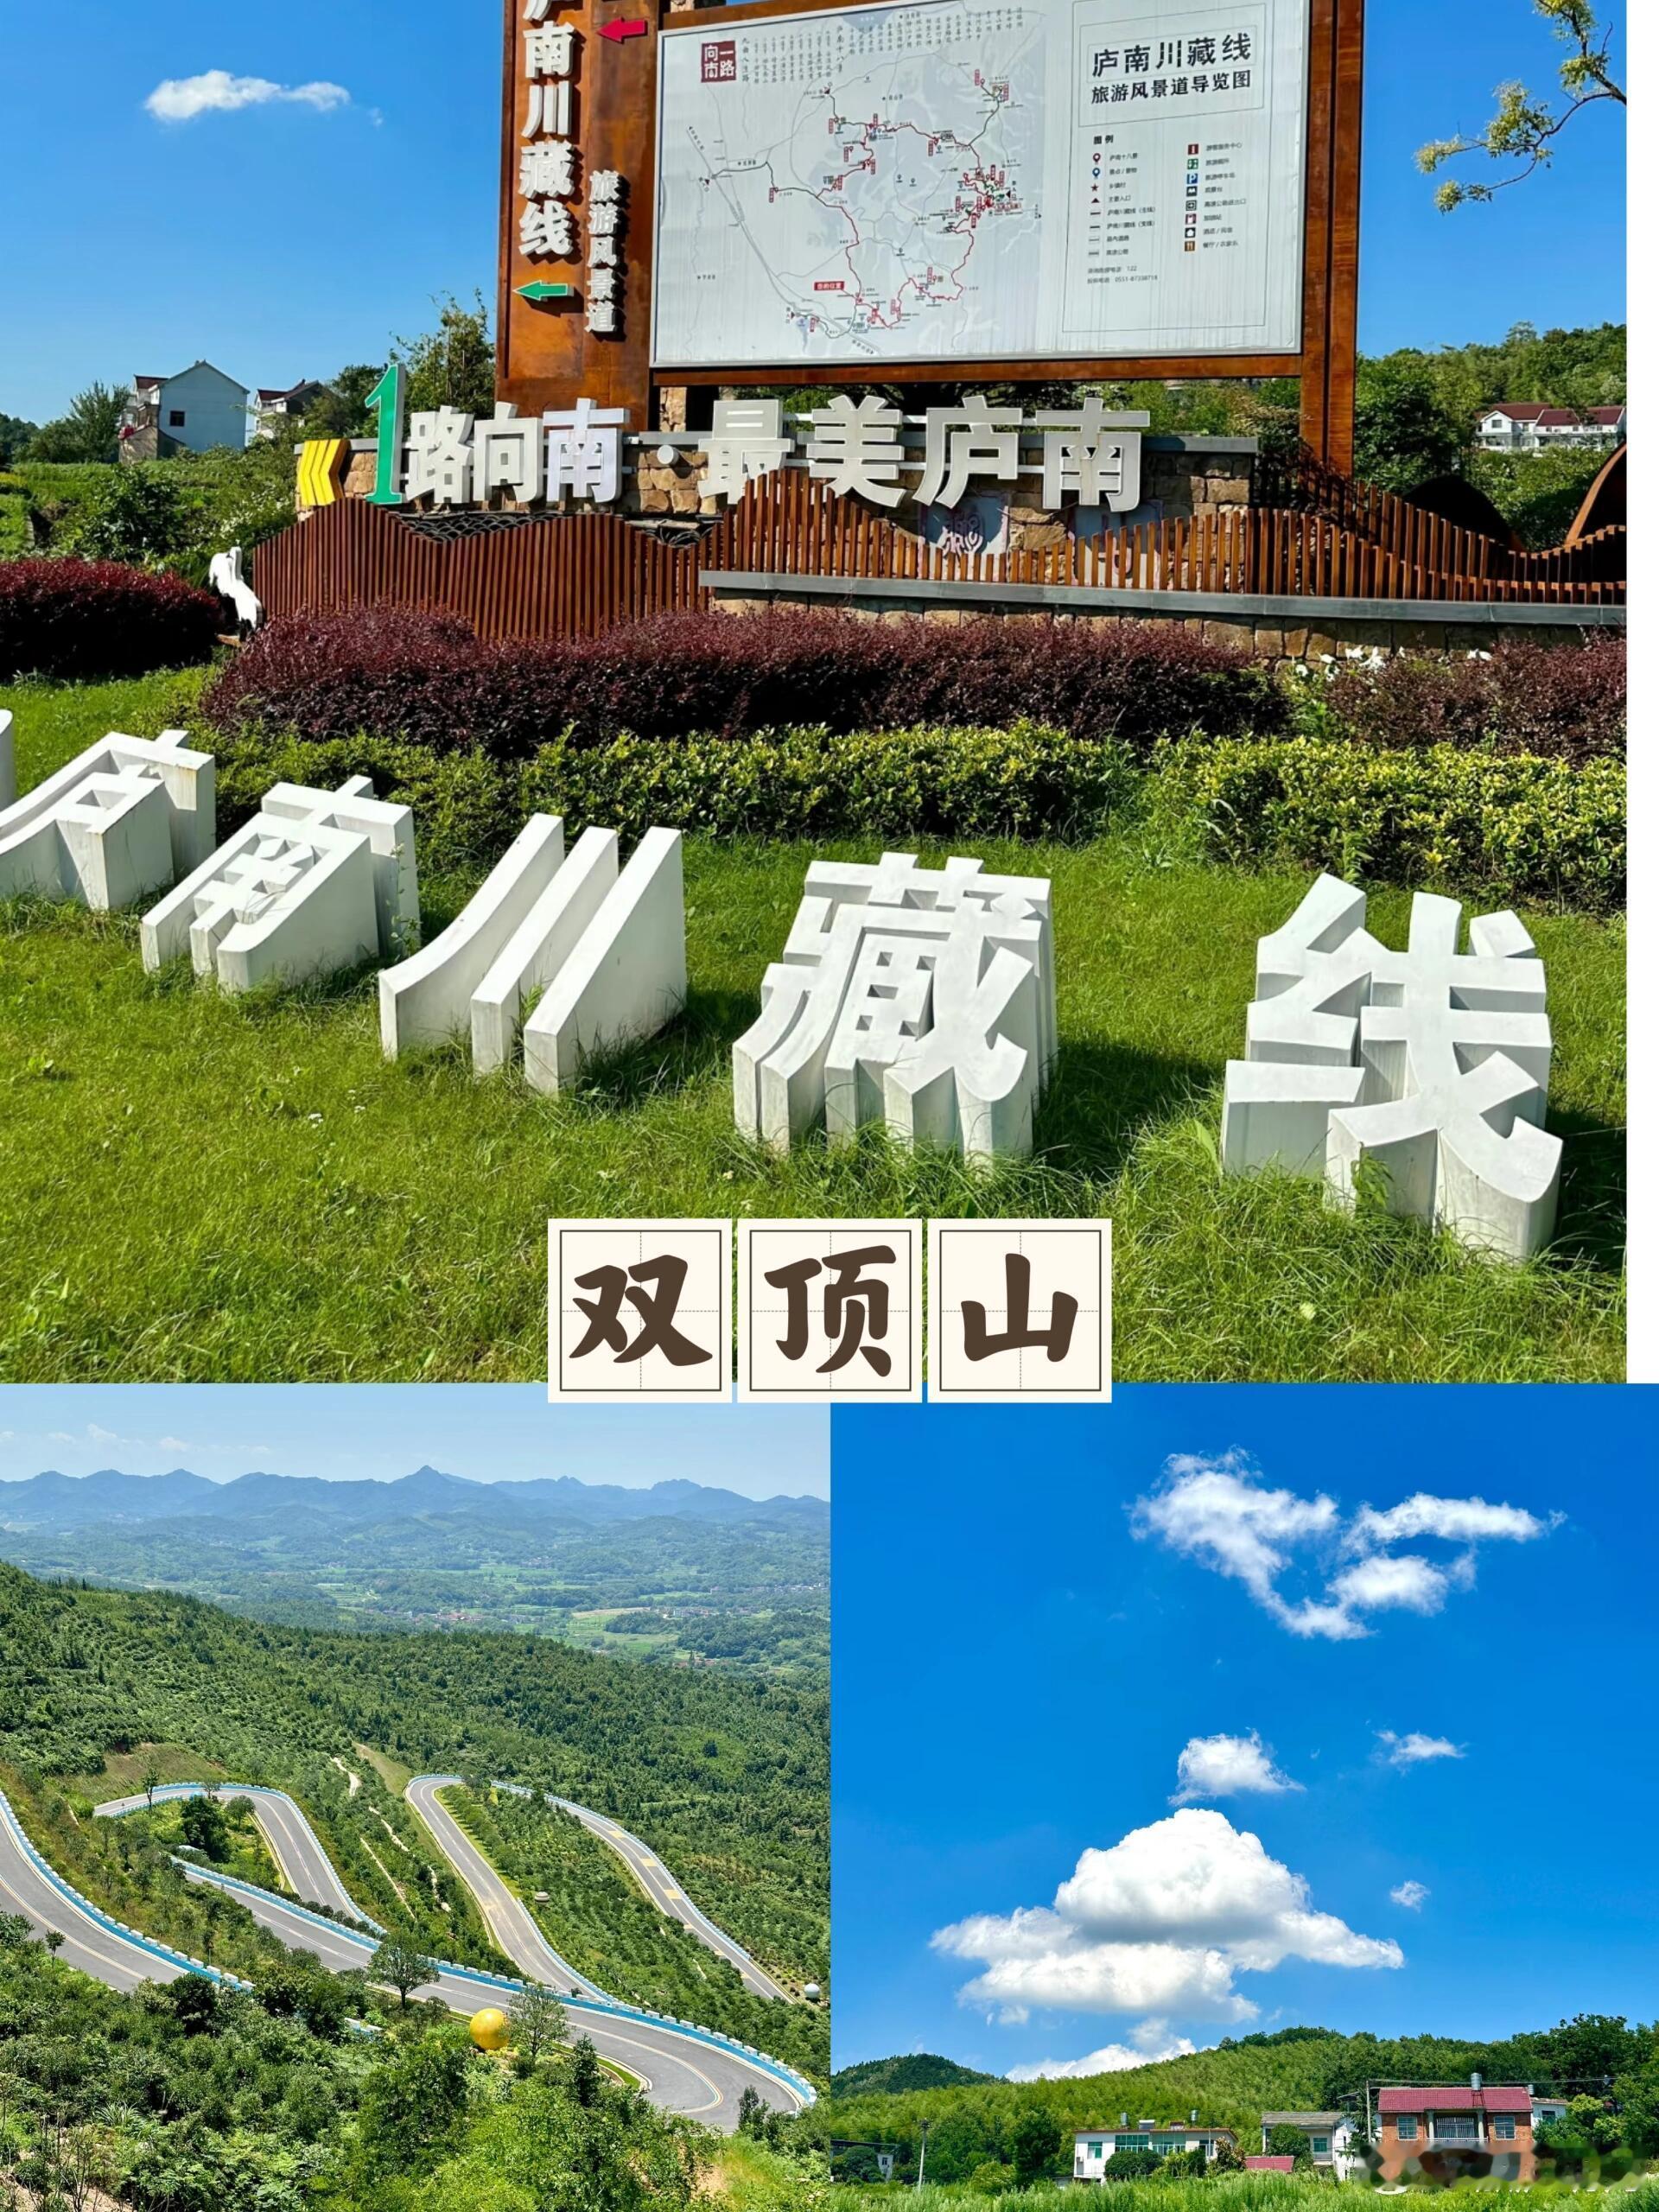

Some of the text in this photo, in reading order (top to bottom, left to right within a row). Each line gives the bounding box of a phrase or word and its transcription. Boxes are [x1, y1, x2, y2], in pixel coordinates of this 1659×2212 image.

[1091, 69, 1252, 105] 旅游风景道导览图
[1092, 32, 1252, 77] 庐南川藏线
[518, 0, 578, 256] 南川藏线
[584, 168, 622, 334] 旅游风景道
